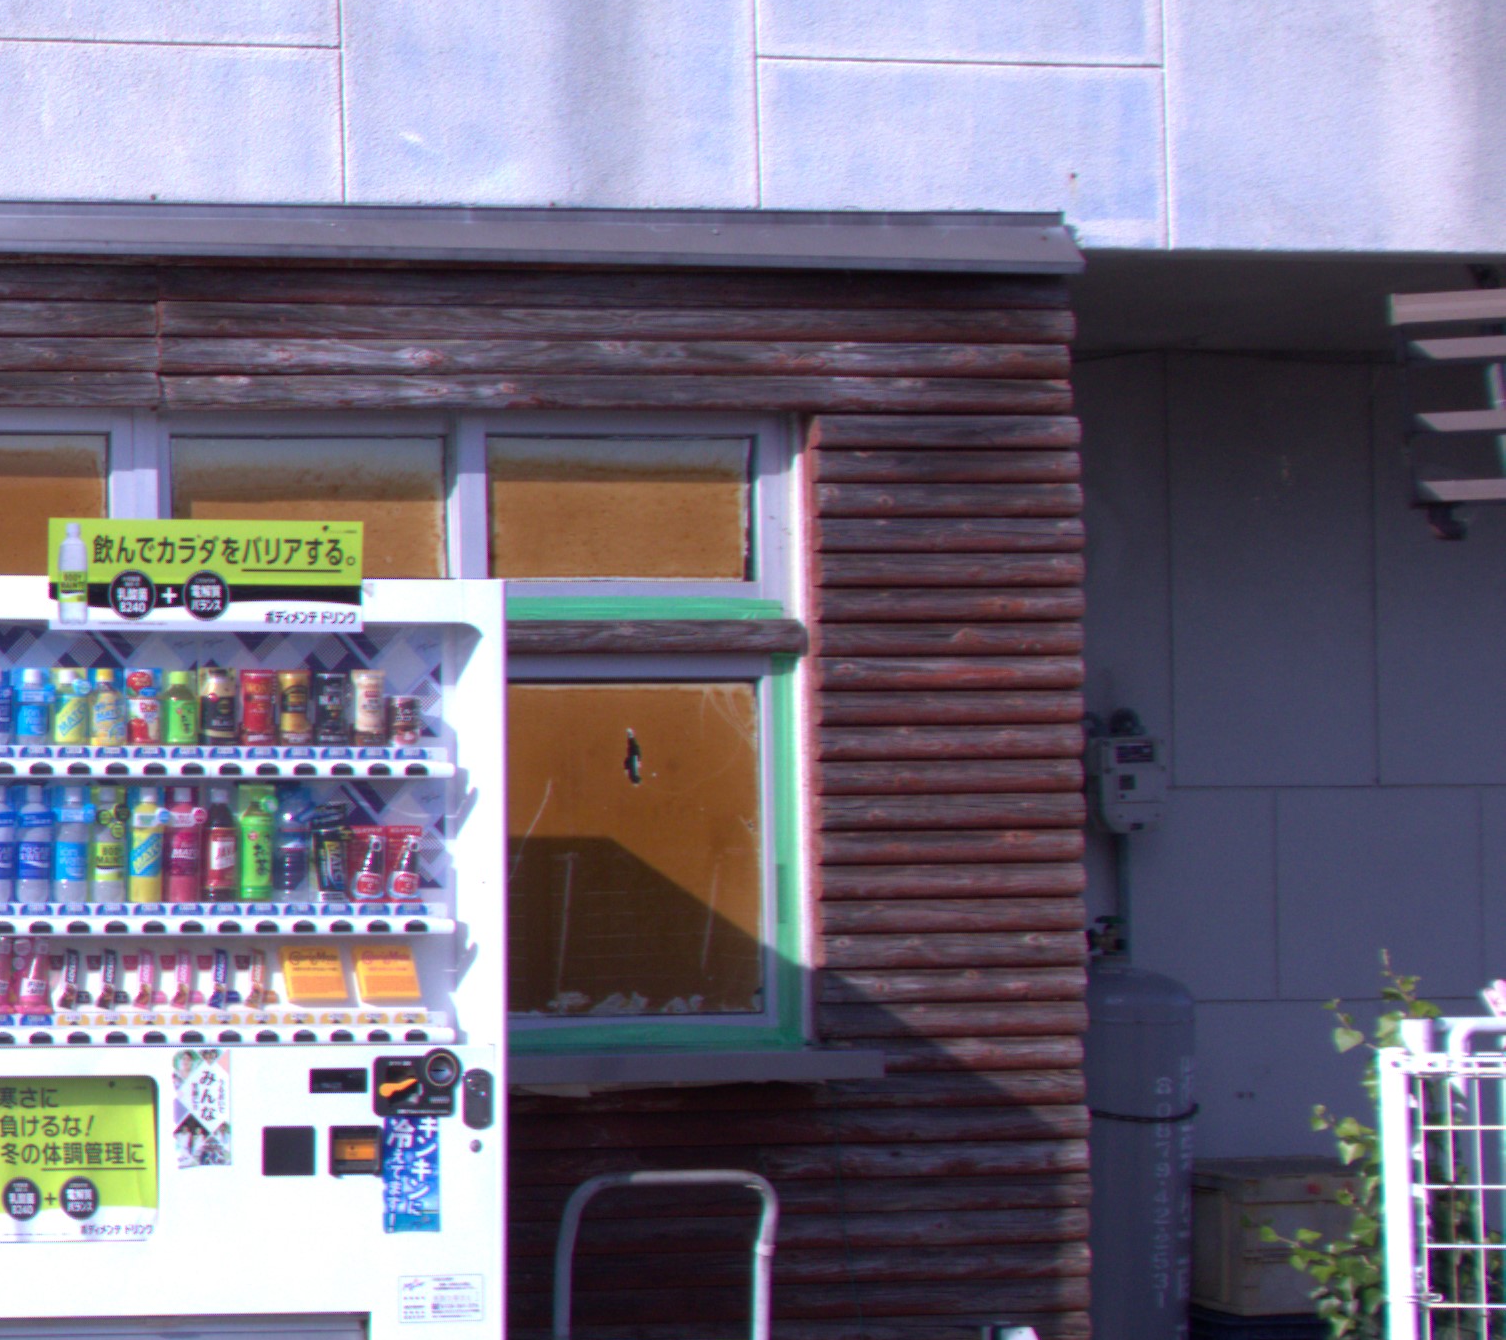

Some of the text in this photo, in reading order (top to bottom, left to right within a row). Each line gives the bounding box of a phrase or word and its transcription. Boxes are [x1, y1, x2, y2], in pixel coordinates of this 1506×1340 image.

[92, 534, 356, 566] 飲んでカラダをバリアする。
[199, 1070, 216, 1122] みんな
[0, 1141, 146, 1166] 冬の体調管理に
[407, 1117, 439, 1217] キンキンに
